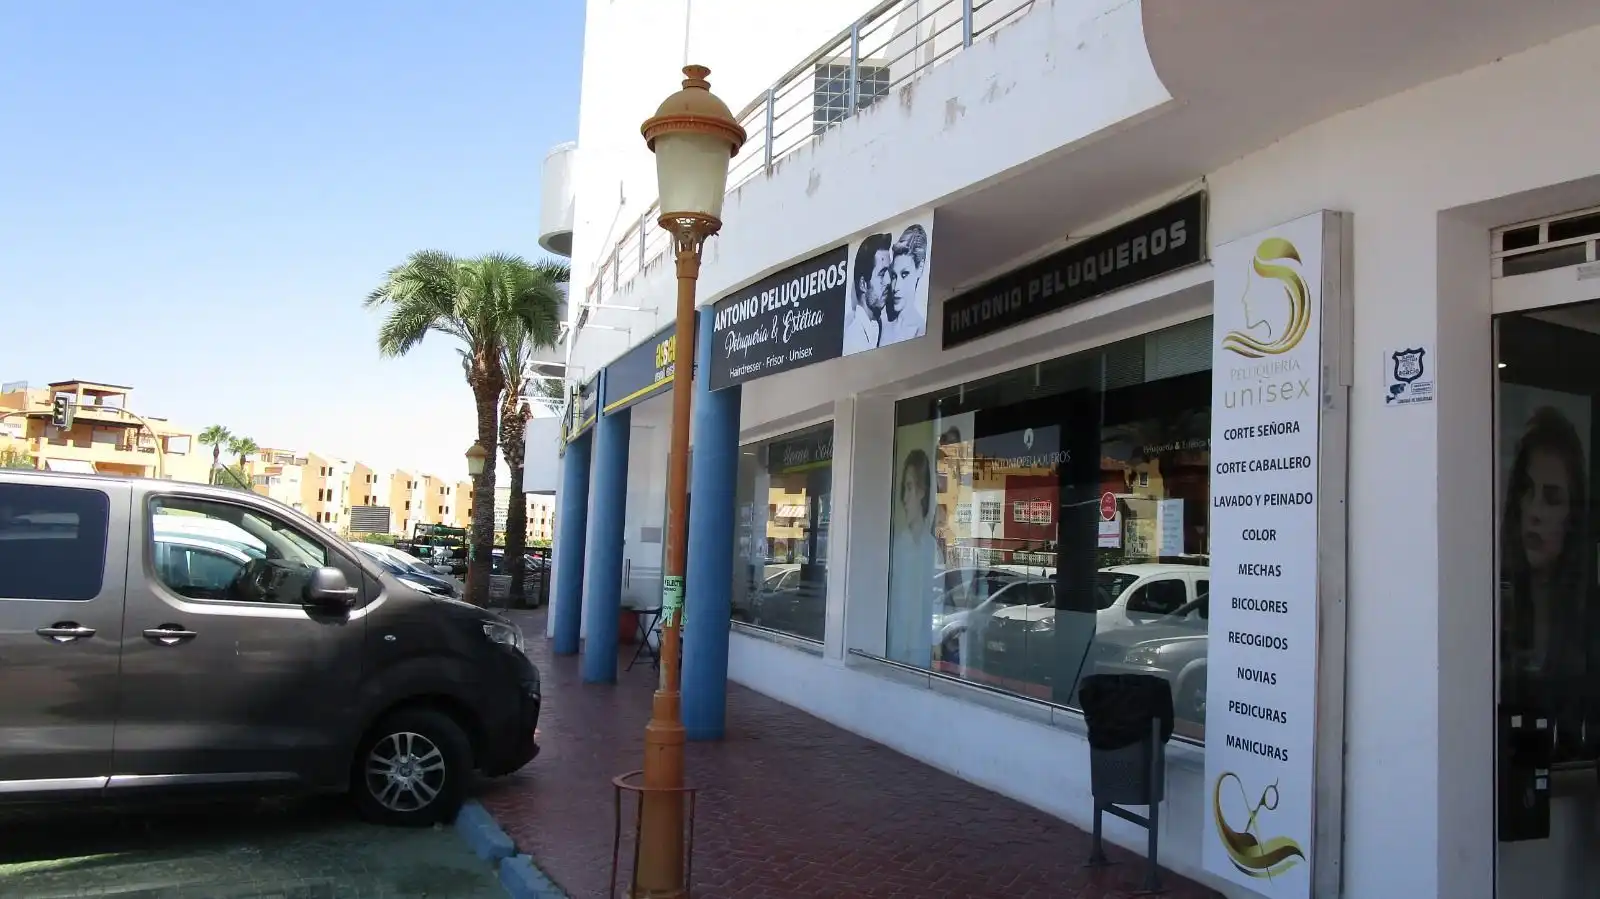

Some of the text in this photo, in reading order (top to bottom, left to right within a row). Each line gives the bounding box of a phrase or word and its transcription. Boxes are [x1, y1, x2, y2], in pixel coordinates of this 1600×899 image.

[951, 218, 1187, 332] ANTONIO PELUQUEROS
[713, 260, 847, 333] ANTONIO PELUQUEROS
[725, 307, 825, 359] Peluquería & Estética
[729, 361, 762, 379] Hairdresser
[789, 346, 813, 362] Unisex
[1230, 357, 1301, 382] PELUQUERÍA
[1224, 378, 1311, 409] unisex
[1224, 420, 1301, 441] CORTE SEÑORA
[1216, 455, 1311, 475] CORTE CABALLERO
[1214, 492, 1313, 508] LAVADO Y PEINADO
[1242, 529, 1277, 542] COLOR
[1238, 563, 1282, 577] MECHAS
[1231, 597, 1288, 614] BICOLORES
[1228, 631, 1288, 650] RECOGIDOS
[1237, 666, 1277, 685] NOVIAS
[1228, 700, 1287, 724] PEDICURAS
[1226, 734, 1288, 761] MANICURAS
